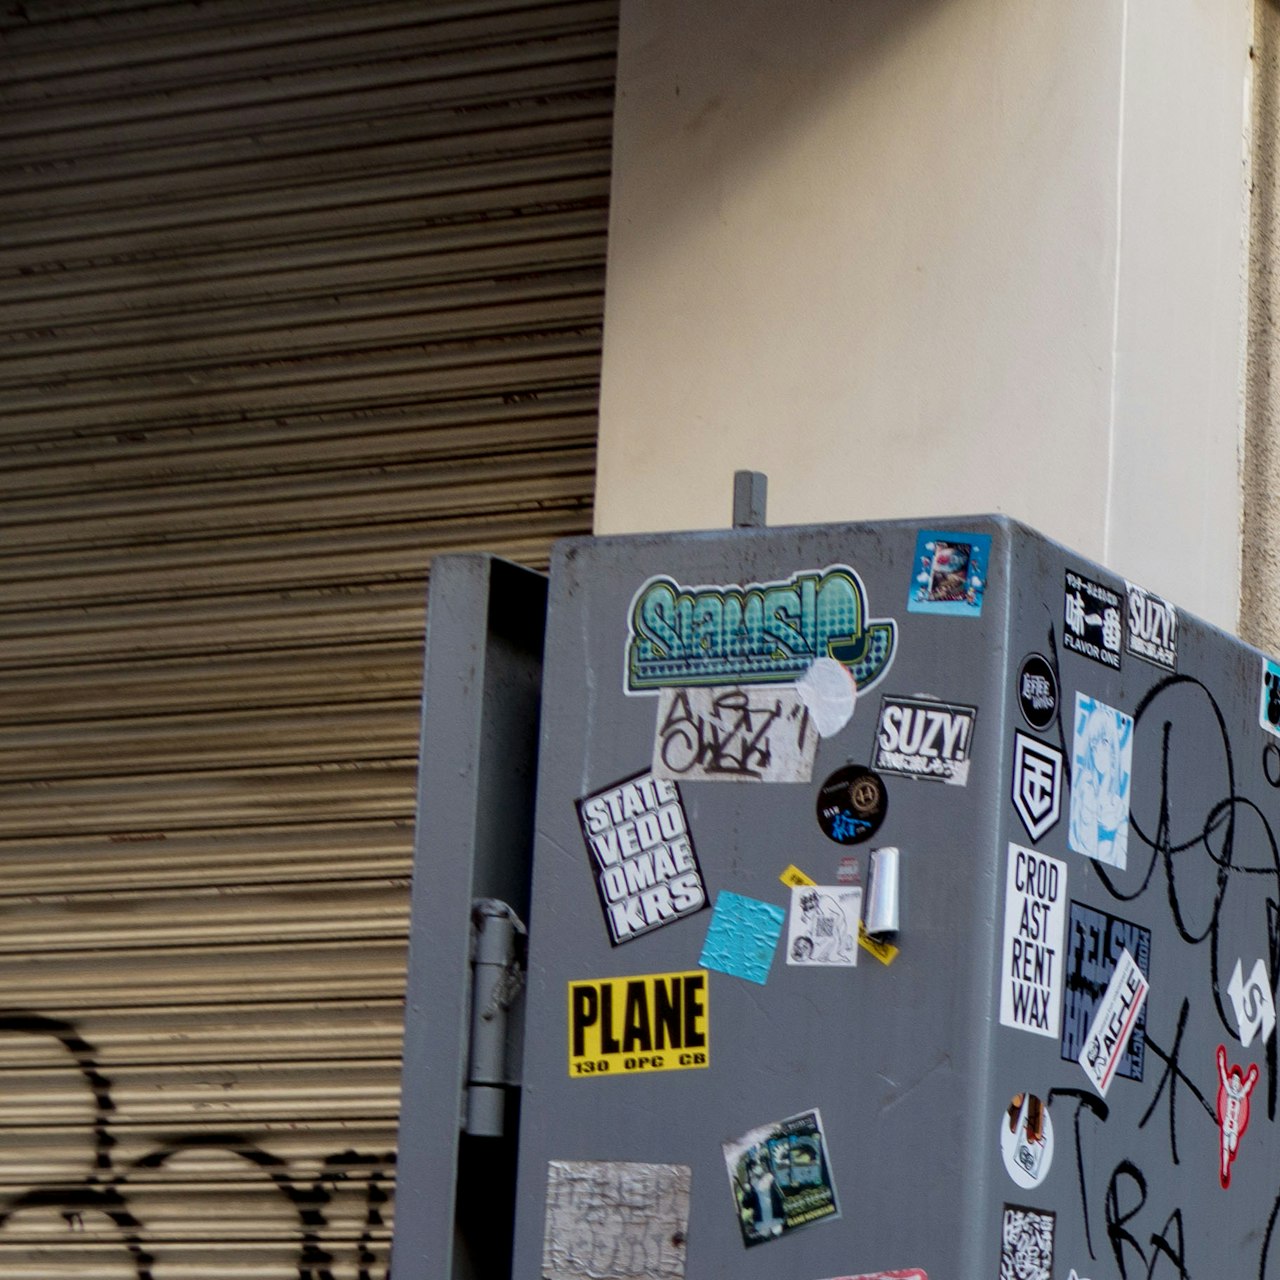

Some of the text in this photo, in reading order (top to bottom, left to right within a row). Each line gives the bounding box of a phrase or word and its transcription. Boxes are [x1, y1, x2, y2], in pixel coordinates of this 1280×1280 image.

[1065, 591, 1121, 653] 味一番
[1128, 591, 1175, 652] SUZY!
[1064, 633, 1100, 660] FLAVOR
[1100, 648, 1120, 668] ONE
[879, 705, 970, 760] SUZY!
[583, 777, 677, 835] STATE
[592, 804, 685, 867] VEDO
[603, 840, 692, 903] OMAE
[1014, 852, 1058, 902] CROD
[610, 877, 703, 938] KRS
[1020, 897, 1050, 943] AST
[1012, 939, 1055, 991] RENT
[573, 976, 705, 1057] PLANE
[1012, 981, 1050, 1031] WAX
[575, 1051, 708, 1074] 130 OPC CB
